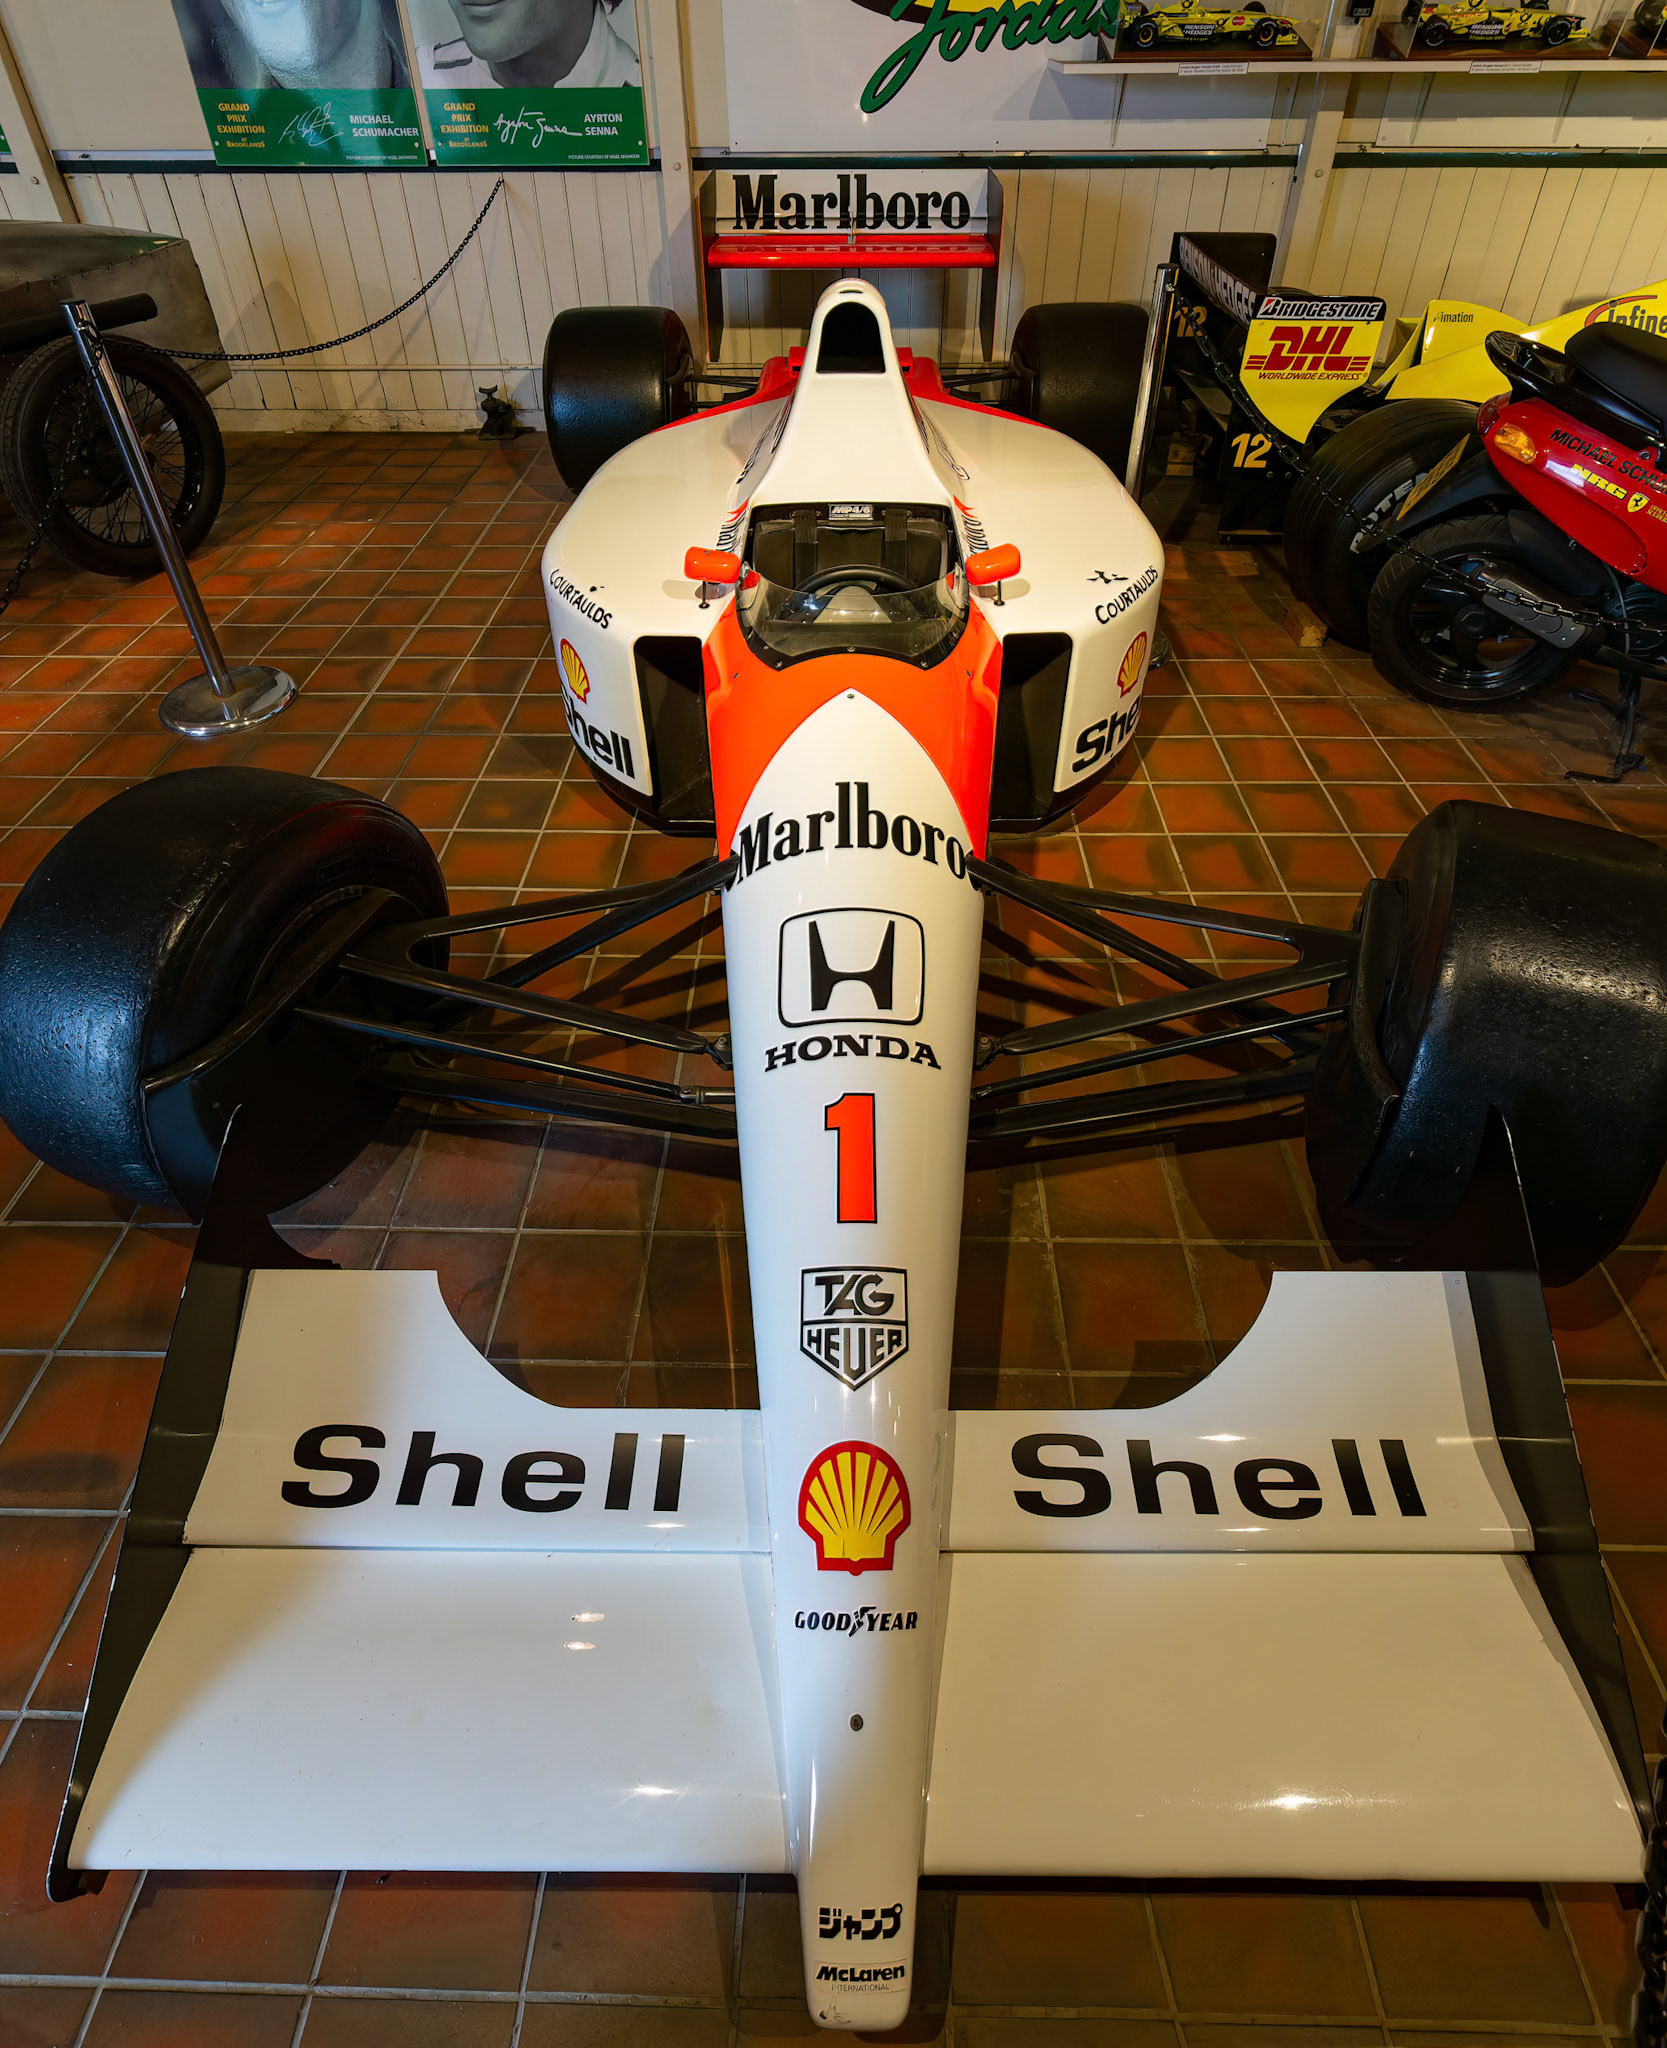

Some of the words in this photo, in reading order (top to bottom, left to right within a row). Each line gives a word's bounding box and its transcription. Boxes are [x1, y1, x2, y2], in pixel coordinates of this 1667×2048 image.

[218, 102, 250, 111] GRAND
[227, 114, 247, 122] PRIX
[349, 114, 394, 124] MICHAEL
[443, 102, 475, 111] GRAND
[451, 113, 471, 122] PRIX
[584, 113, 623, 122] AYRTON
[217, 125, 265, 133] EXHIBITION
[352, 127, 419, 136] SCHUMACHER
[440, 124, 489, 133] EXHIBITION
[585, 126, 619, 136] SENNA
[732, 173, 971, 230] Marlboro
[1174, 305, 1208, 337] 12
[1256, 297, 1384, 320] BRIDGESTONE
[1440, 311, 1474, 323] imation
[1263, 326, 1354, 372] DHL
[1258, 372, 1317, 380] WORLDWIDE
[1318, 372, 1362, 381] EXPRESS
[1231, 433, 1273, 468] 12
[1550, 428, 1616, 469] MICHAEL
[549, 568, 613, 629] COURTAULDS
[1094, 564, 1159, 625] COURTAULDS
[736, 781, 967, 885] Marlboro
[764, 1034, 941, 1072] HONDA
[824, 1092, 877, 1224] 1
[815, 1273, 894, 1316] TAG
[807, 1327, 903, 1381] HEUER
[281, 1424, 686, 1513] Shell
[1011, 1432, 1427, 1520] Shell
[795, 1609, 918, 1633] GOODYEAR
[818, 1903, 903, 1940] ジャンプ
[816, 1965, 905, 1982] McLaren
